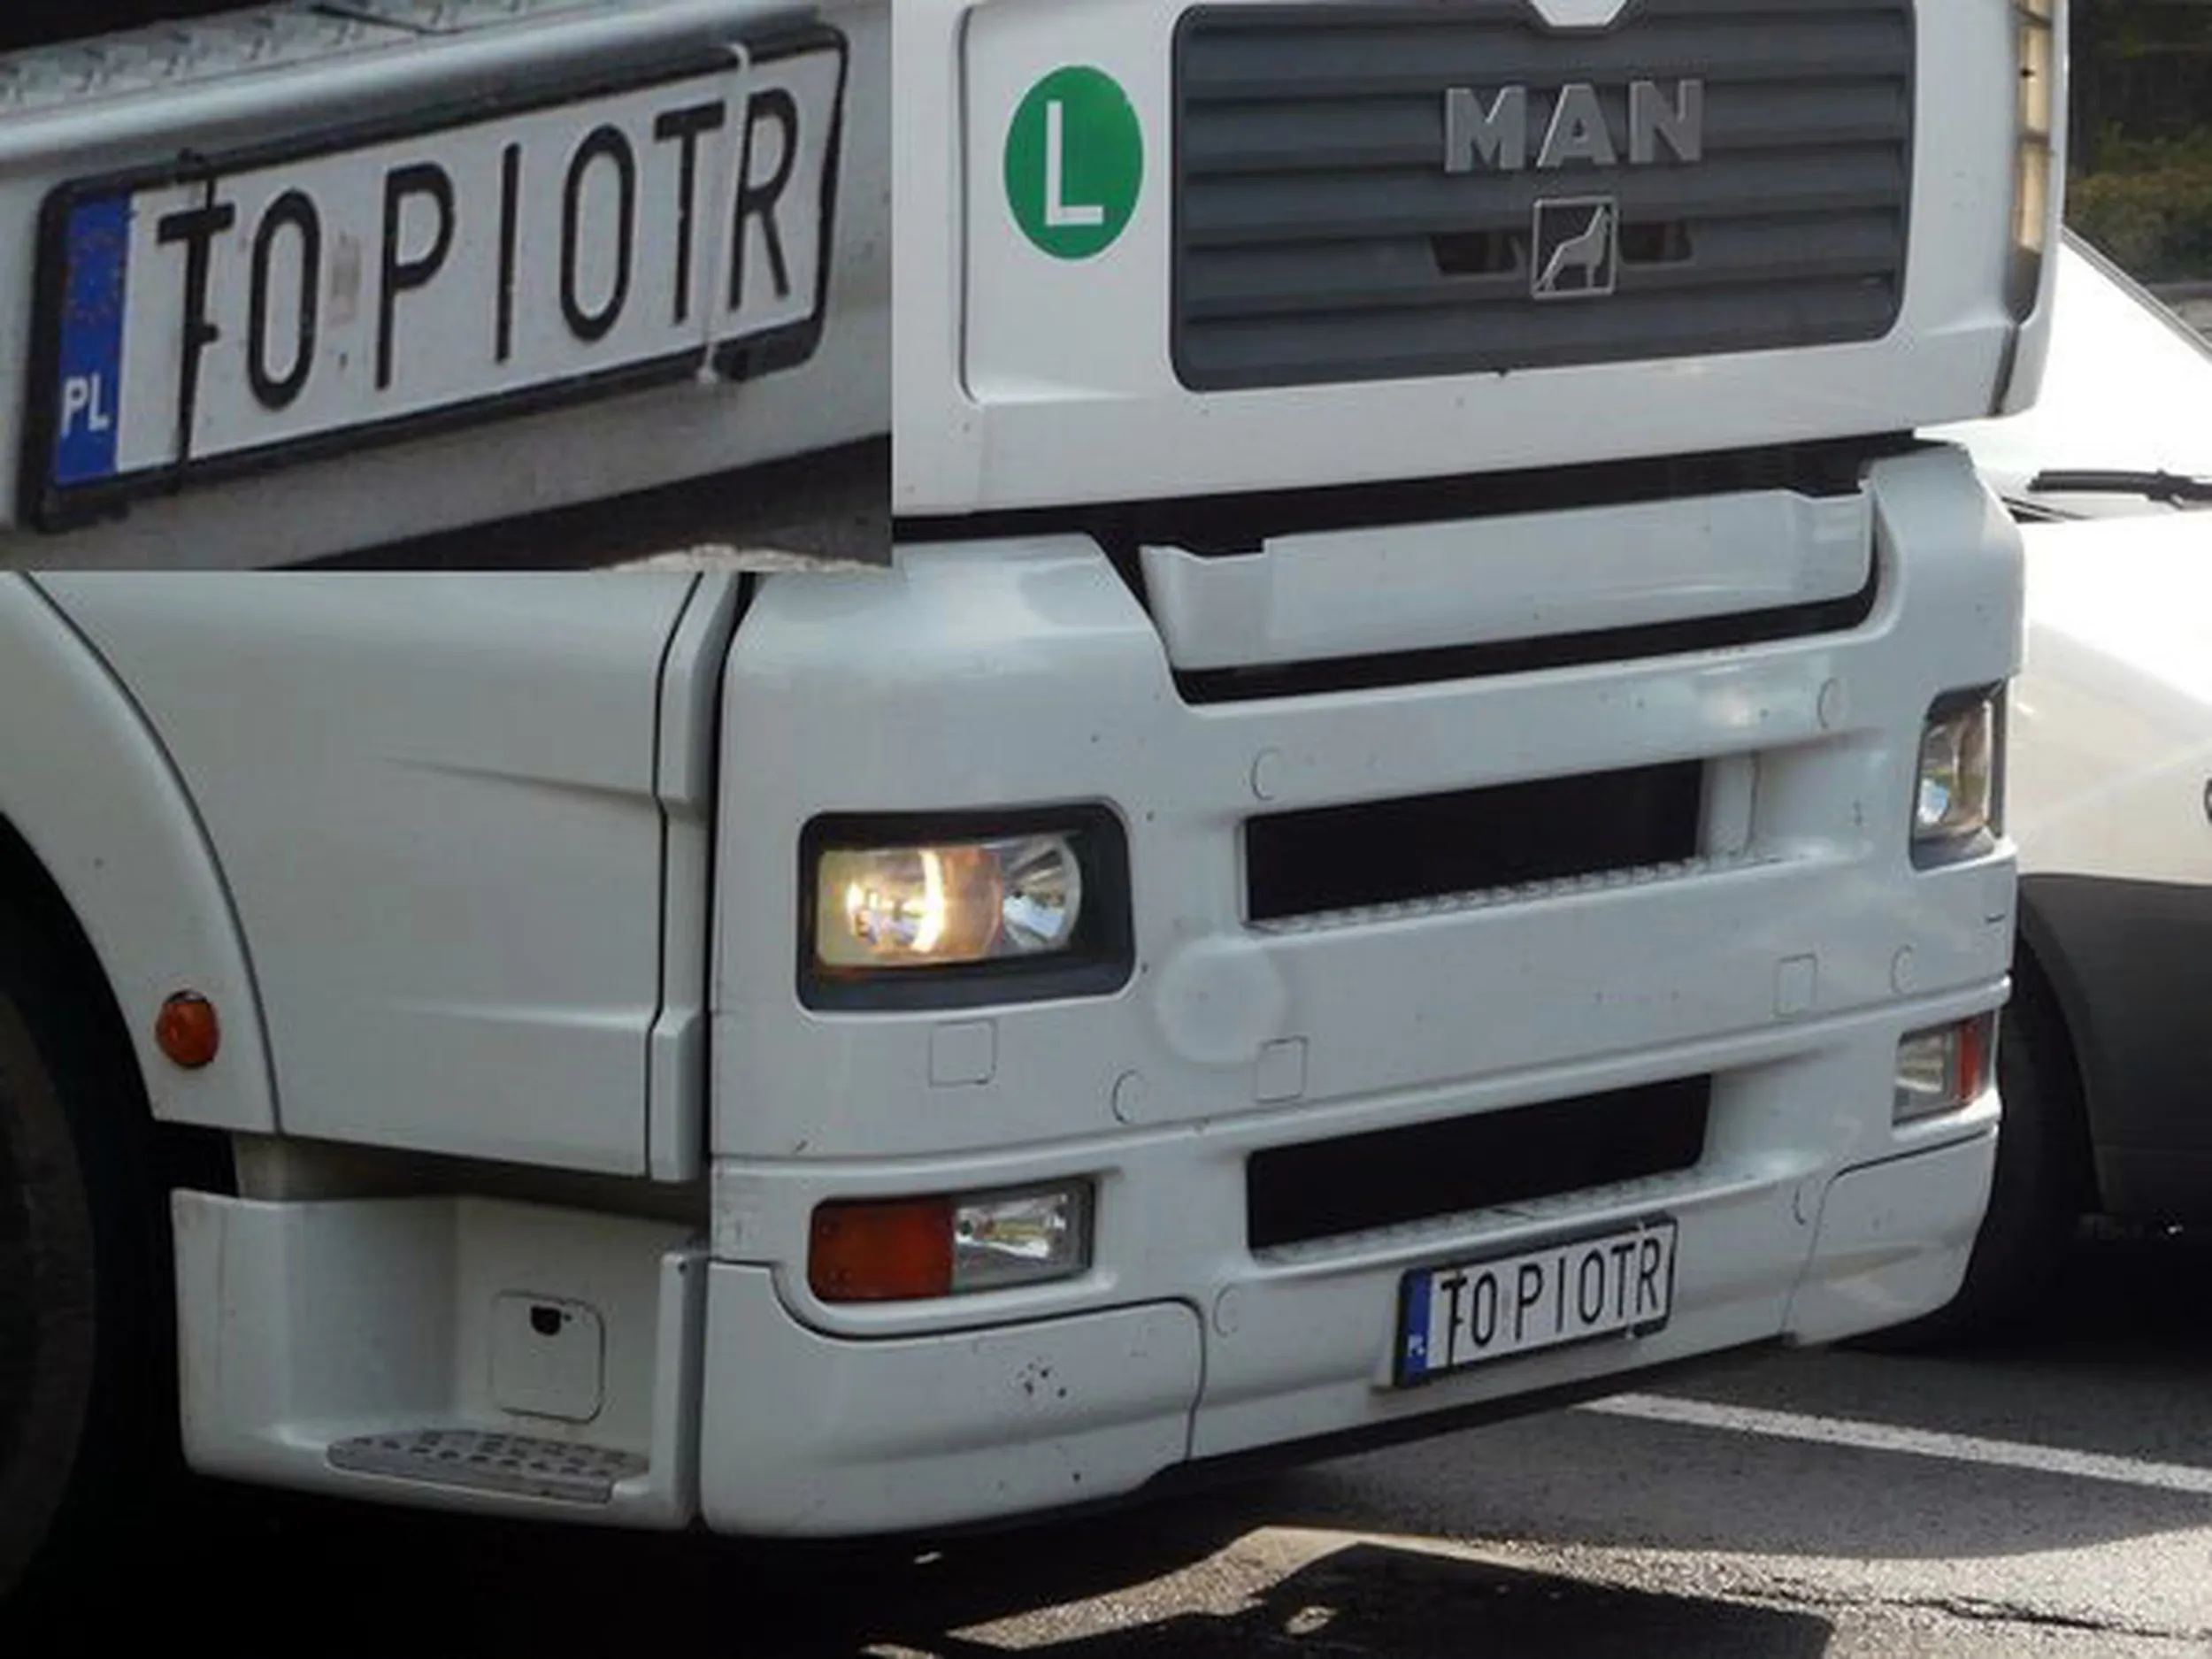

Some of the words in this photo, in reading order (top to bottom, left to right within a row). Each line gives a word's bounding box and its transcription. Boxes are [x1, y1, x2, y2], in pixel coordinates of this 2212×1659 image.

[1045, 100, 1103, 227] L
[1444, 80, 1703, 173] MAN
[375, 87, 799, 390] PIOTR
[60, 375, 111, 437] PL
[1515, 1238, 1661, 1341] PIOTR
